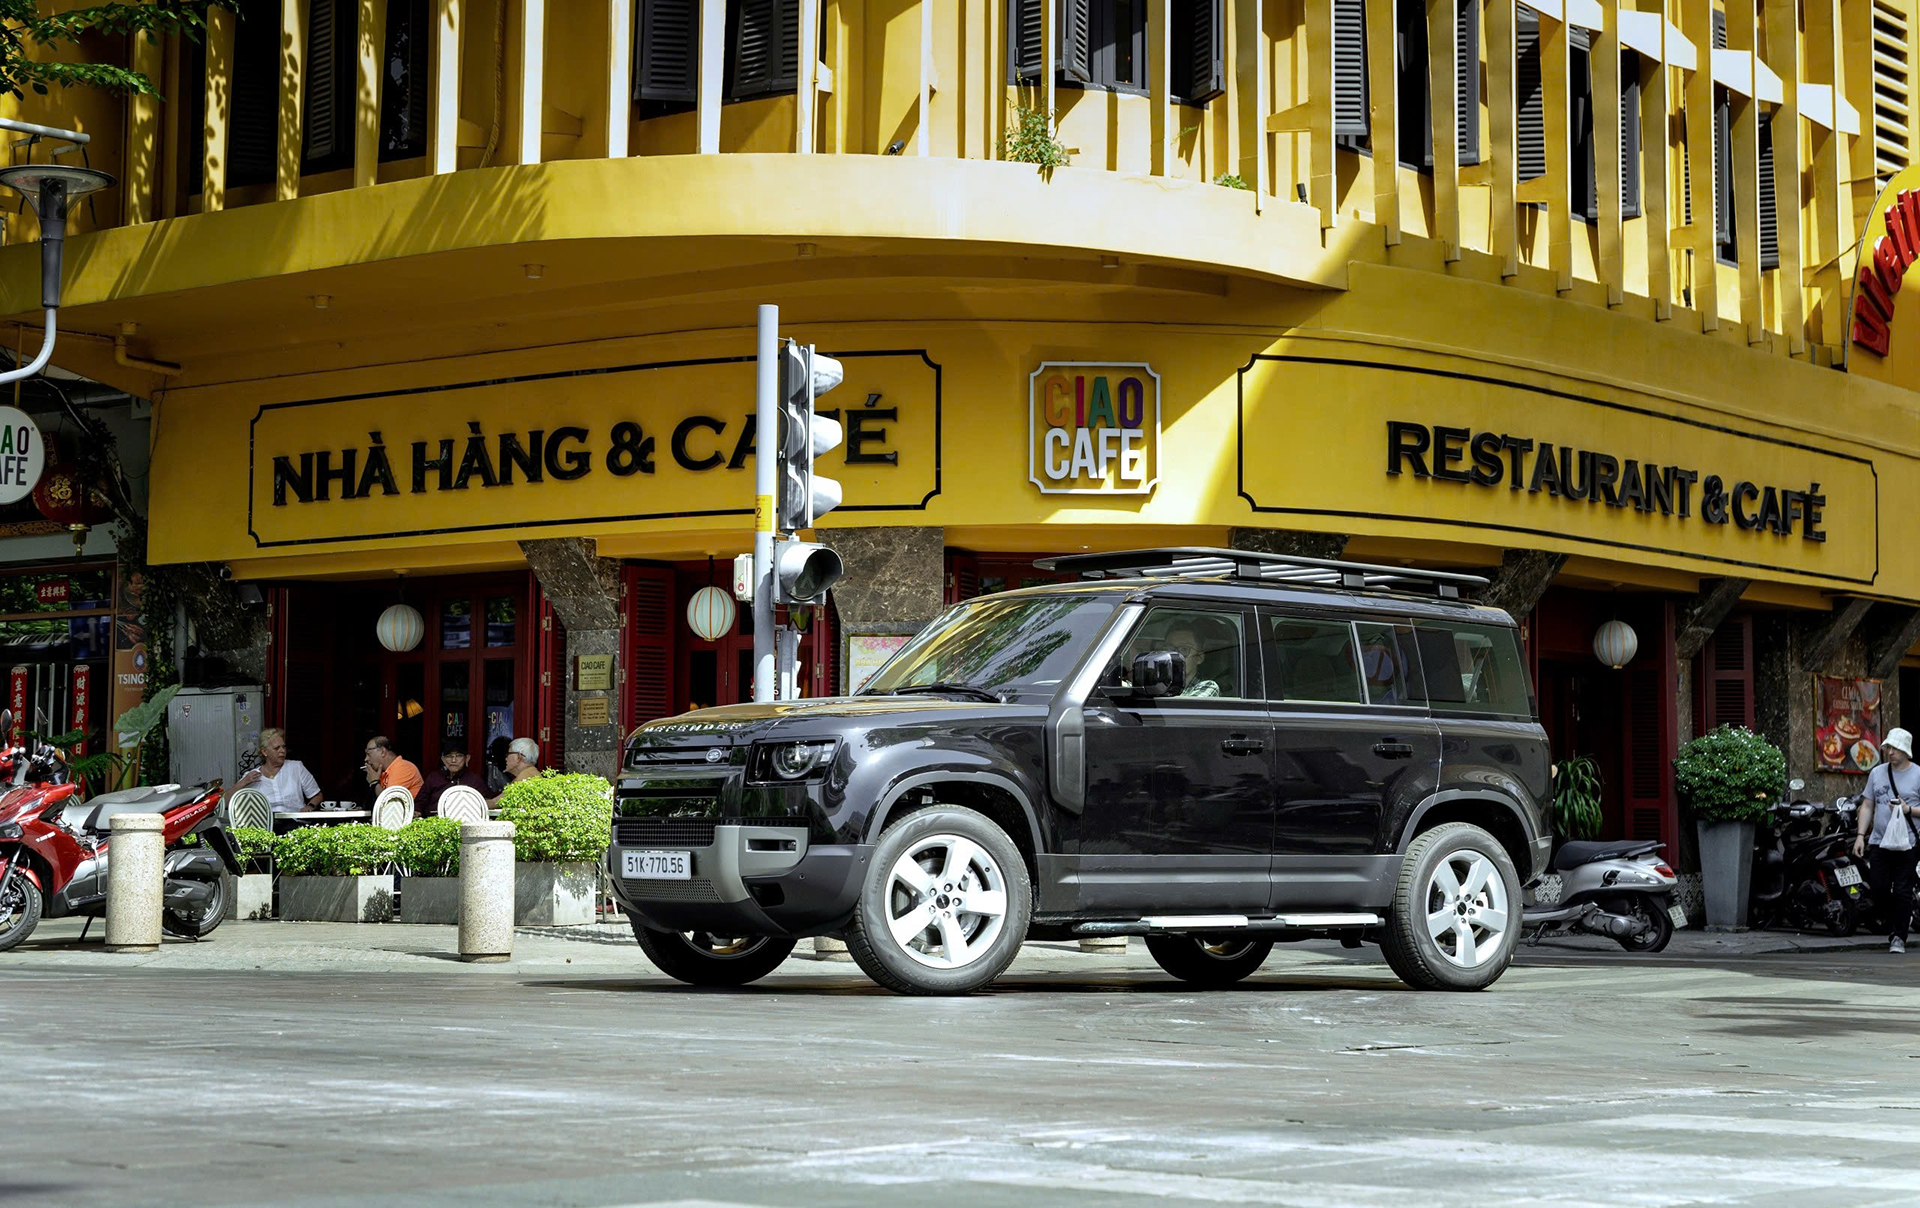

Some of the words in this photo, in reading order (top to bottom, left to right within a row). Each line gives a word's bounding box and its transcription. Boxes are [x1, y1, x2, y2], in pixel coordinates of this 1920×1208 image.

[1045, 375, 1144, 428] CIAO
[273, 431, 400, 506] NHÀ
[411, 421, 592, 494] HÀNG
[605, 421, 656, 477] &
[671, 393, 898, 471] CAÉ
[1044, 427, 1144, 480] CAFE
[1386, 420, 1698, 518] RESTAURANT
[1701, 475, 1729, 524] &
[1732, 482, 1827, 542] CAFÉ
[593, 660, 605, 670] CAFE
[446, 724, 464, 737] CAFE
[447, 712, 464, 726] CIAO
